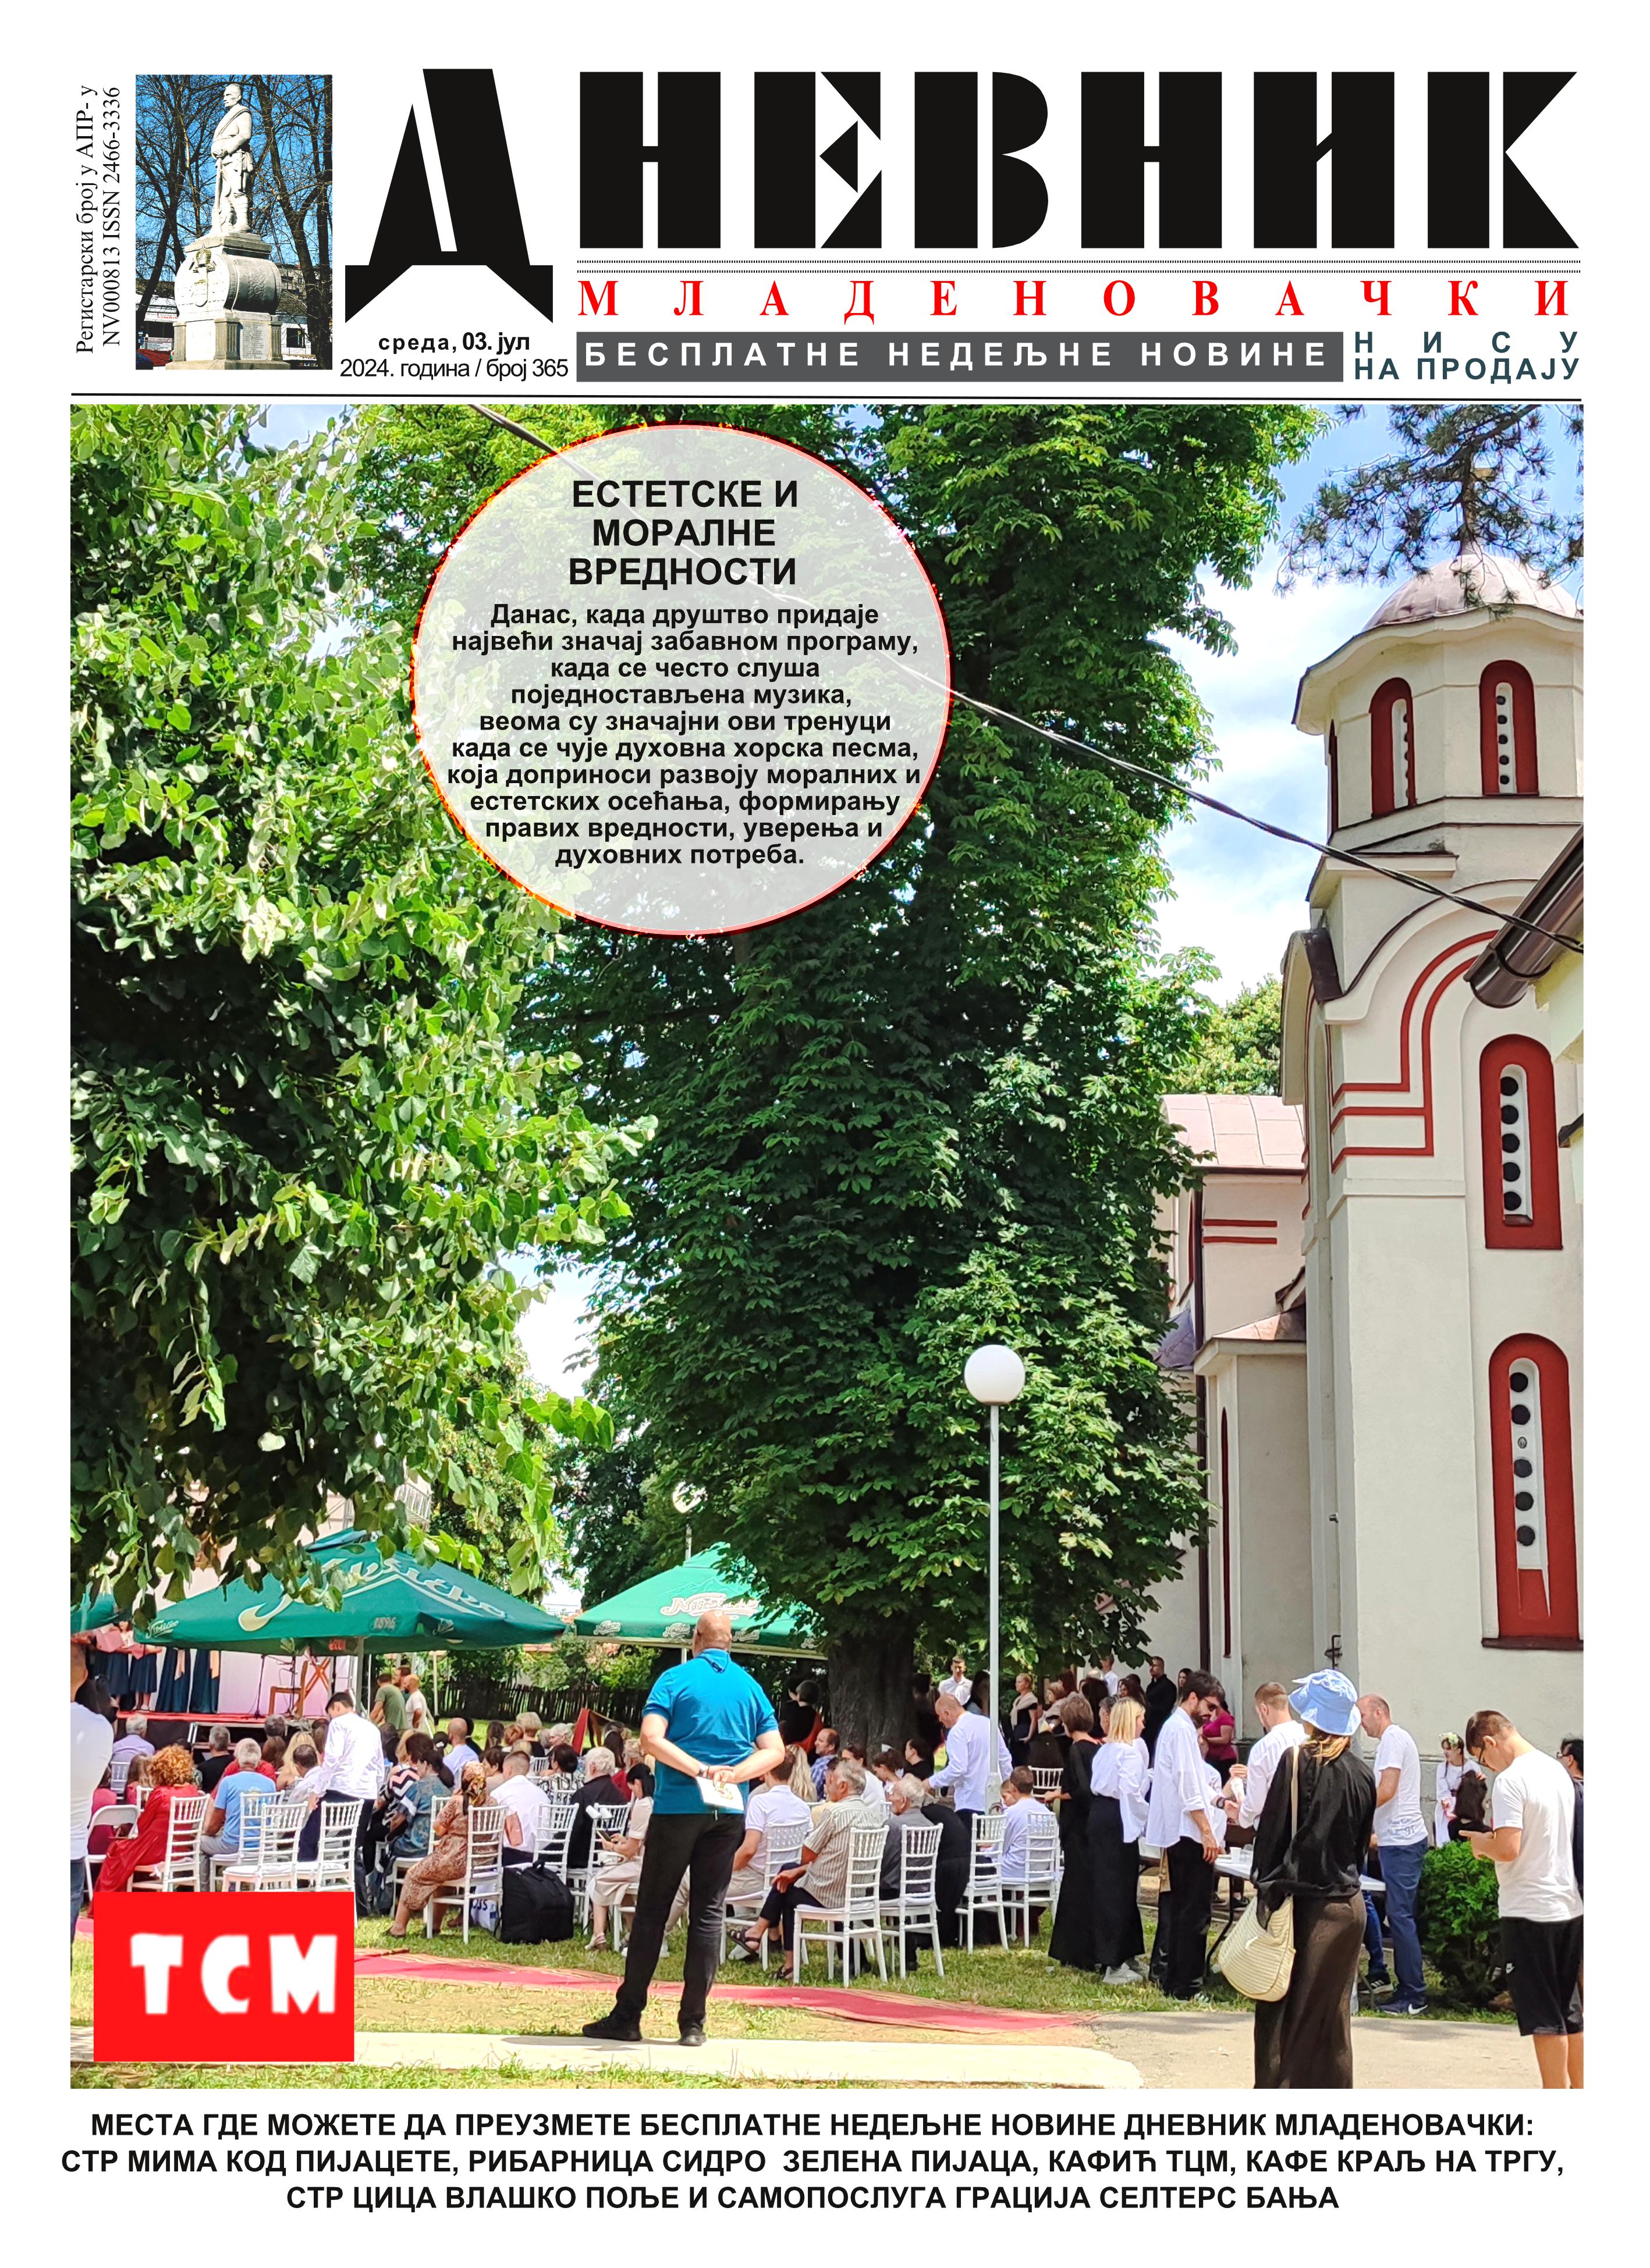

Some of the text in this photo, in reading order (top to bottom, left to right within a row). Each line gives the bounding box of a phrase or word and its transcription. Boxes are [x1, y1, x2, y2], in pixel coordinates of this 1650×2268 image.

[345, 69, 1578, 323] ДНЕВНИК
[76, 86, 98, 353] Регистарски број у АПР- у
[103, 88, 119, 346] NV000813 ISSN 2466-3336
[579, 280, 1567, 323] МЛАДЕНОВАЧКИ
[379, 332, 529, 355] среда, 03. јул
[1356, 332, 1577, 353] НИСУ
[340, 358, 568, 381] 2024. година / број 365
[586, 343, 1323, 371] БЕСПЛАТНЕ НЕДЕЉНЕ НОВИНЕ
[1356, 358, 1579, 383] НА ПРОДАЈУ
[93, 2114, 1532, 2139] МЕСТА ГДЕ МОЖЕТЕ ДА ПРЕУЗМЕТЕ БЕСПЛАТНЕ НЕДЕЉНЕ НОВИНЕ ДНЕВНИК МЛАДЕНОВАЧКИ:
[62, 2150, 1562, 2176] СТР МИМА КОД ПИЈАЦЕТЕ, РИБАРНИЦА СИДРО ЗЕЛЕНА ПИЈАЦА, КАФИЋ ТЦМ, КАФЕ КРАЉ НА ТРГУ,
[288, 2187, 1339, 2212] СТР ЦИЦА ВЛАШКО ПОЉЕ И САМОПОСЛУГА ГРАЦИЈА СЕЛТЕРС БАЊА
